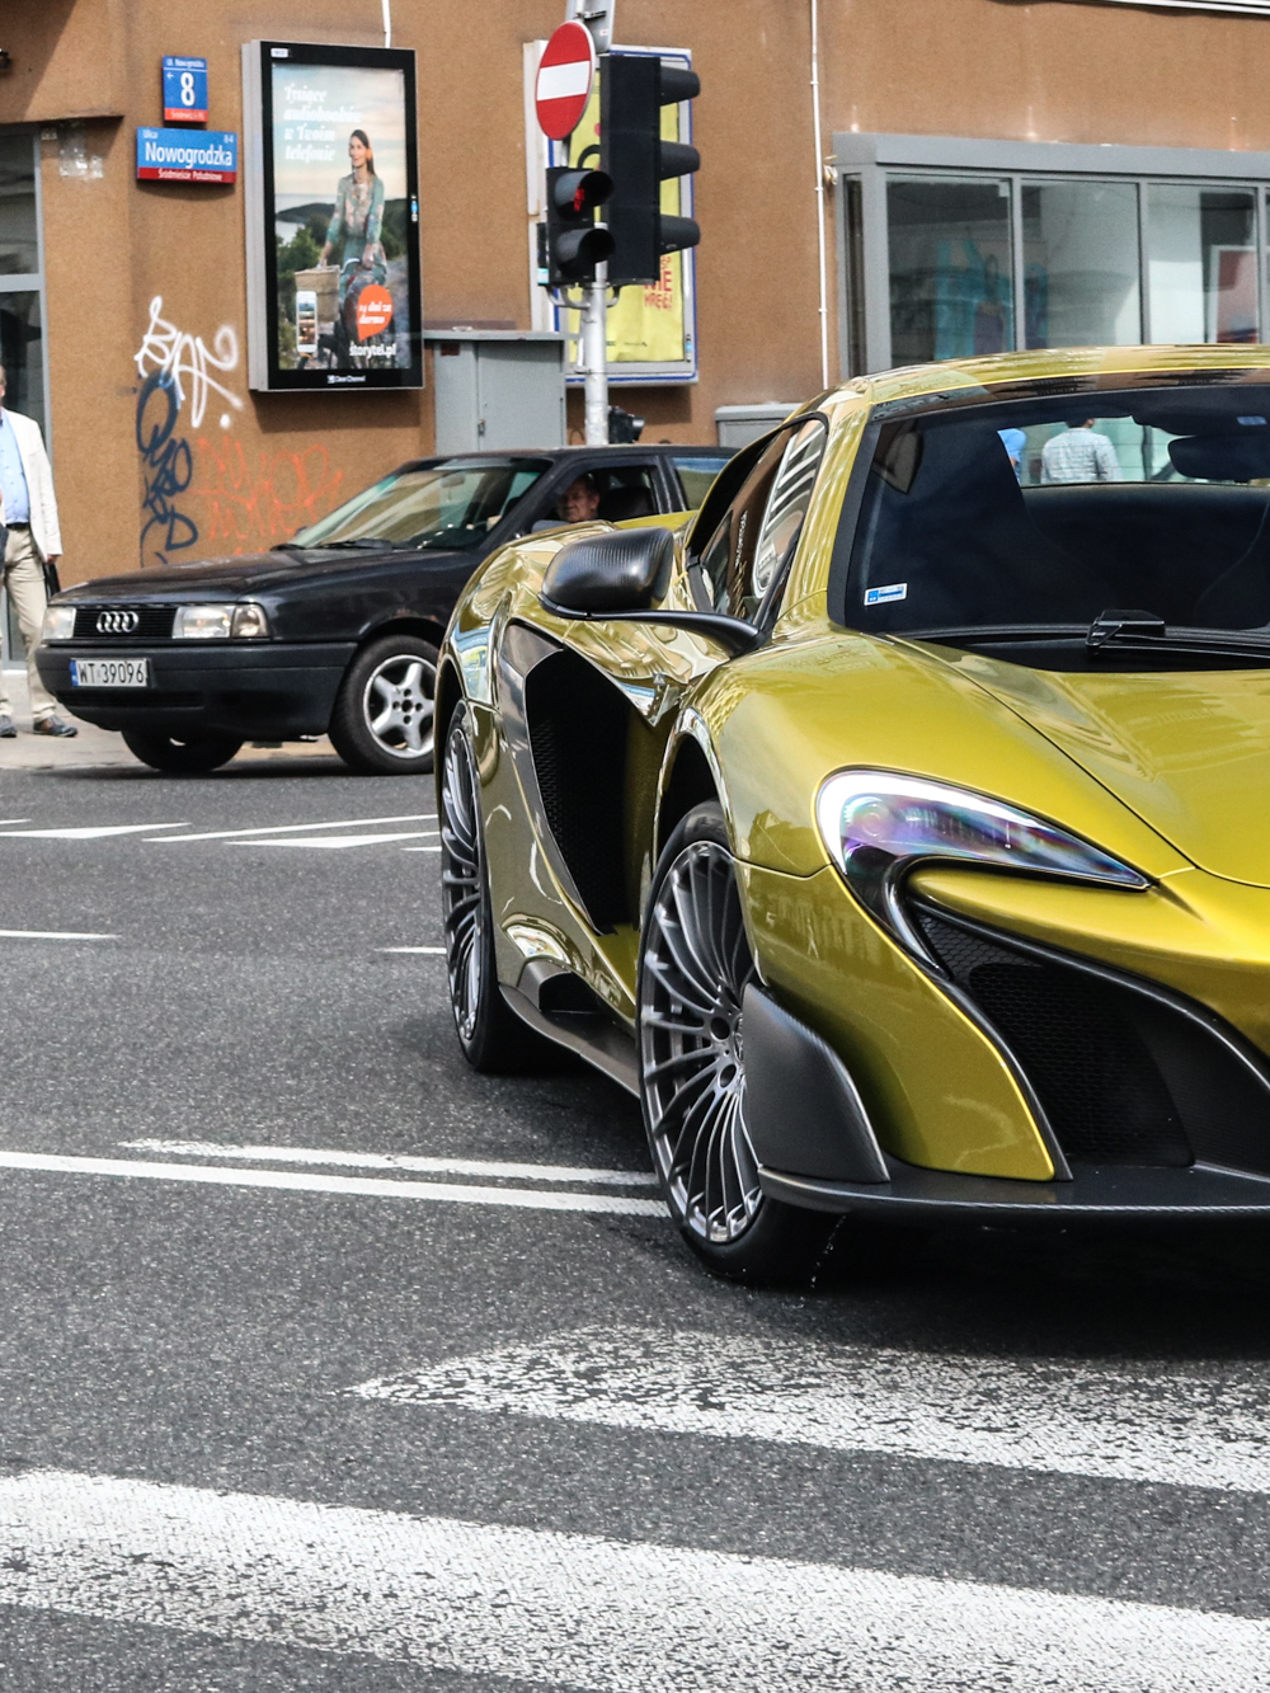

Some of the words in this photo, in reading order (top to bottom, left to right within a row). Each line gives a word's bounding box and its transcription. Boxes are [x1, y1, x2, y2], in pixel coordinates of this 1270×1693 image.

[180, 72, 196, 107] 8
[283, 105, 362, 123] audiobooków
[142, 129, 158, 139] Ulica
[297, 122, 336, 141] Twoim
[145, 141, 233, 169] Nowogrodzka
[285, 144, 336, 163] telefonie
[349, 342, 397, 359] storytel.pl
[78, 663, 95, 683] WT
[100, 662, 144, 684] 39096
